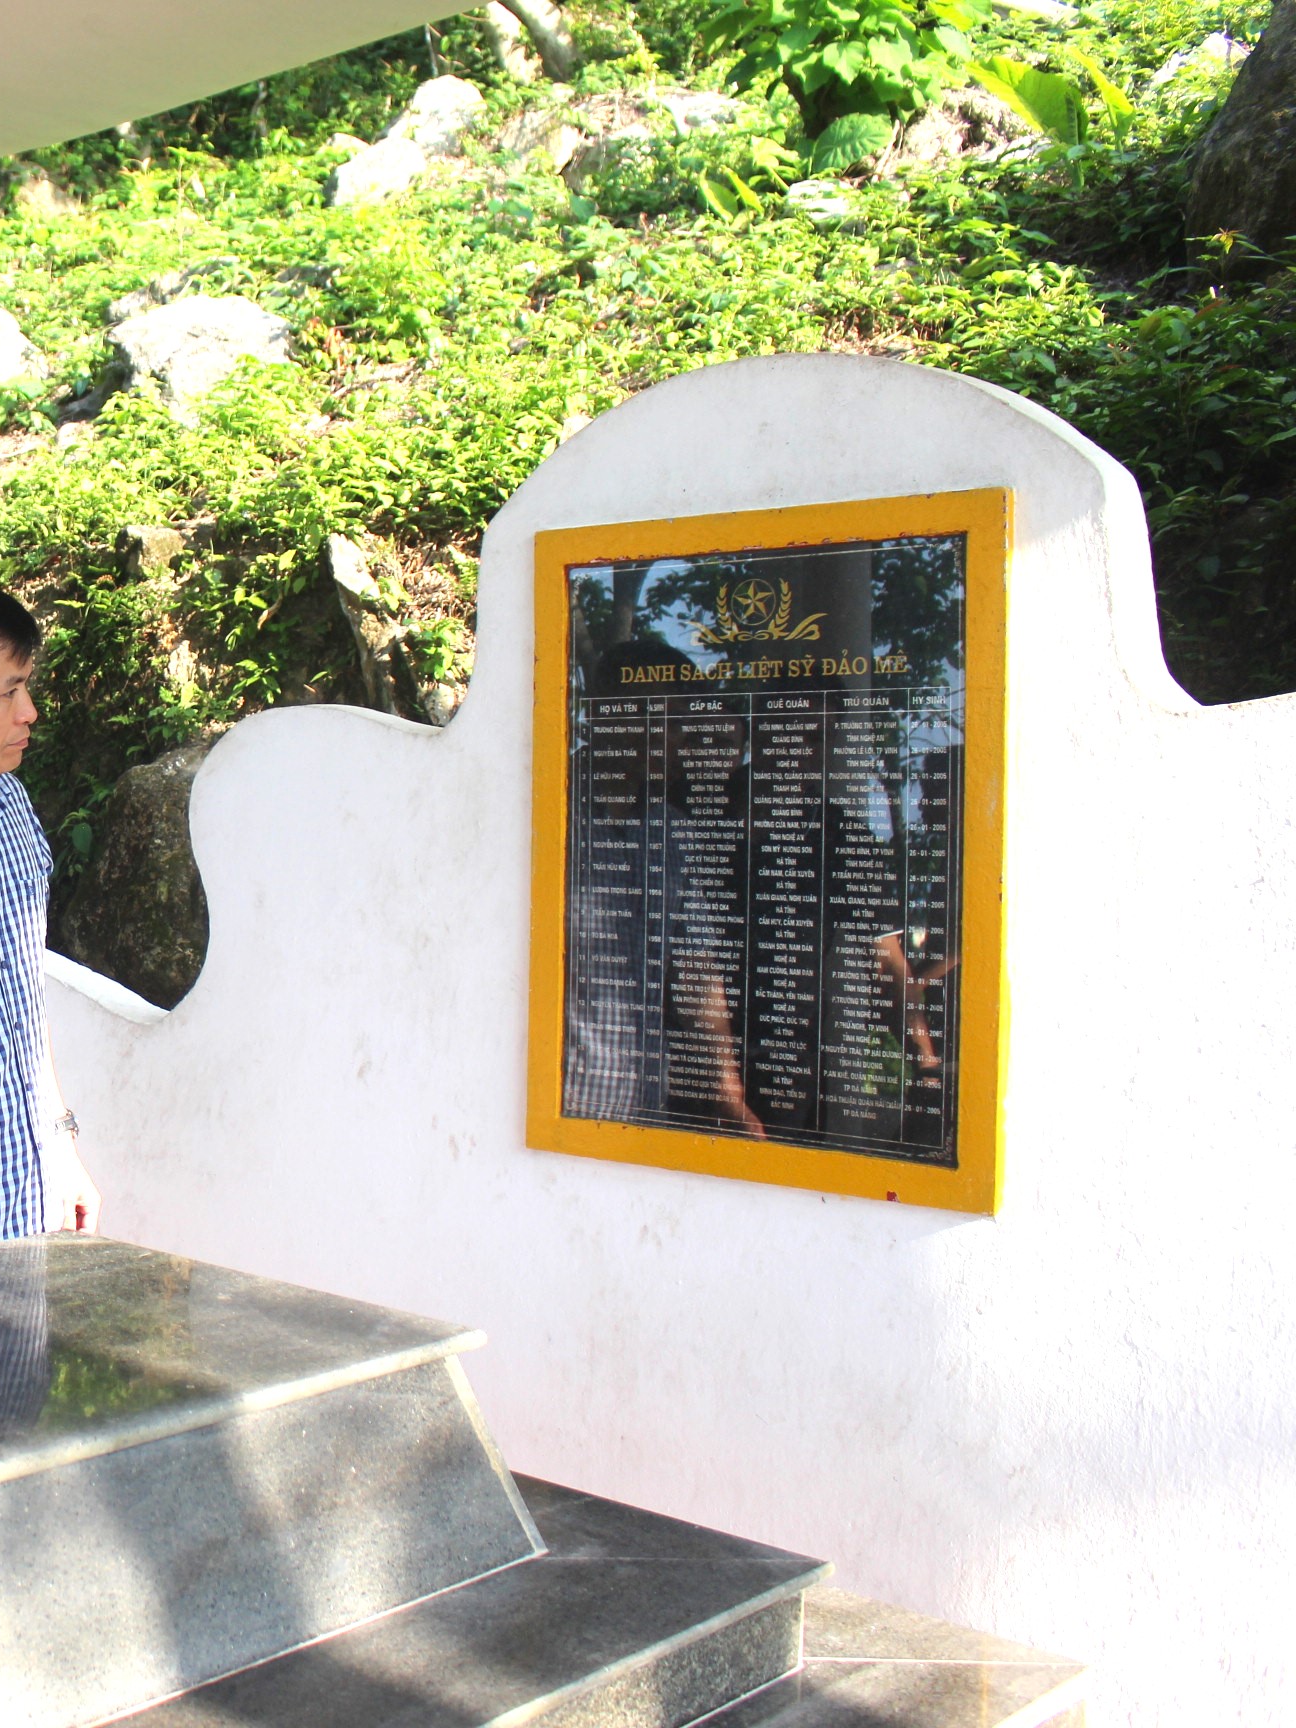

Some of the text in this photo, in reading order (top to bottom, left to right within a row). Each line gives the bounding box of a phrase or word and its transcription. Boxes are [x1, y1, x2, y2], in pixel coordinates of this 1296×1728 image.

[620, 665, 675, 683] DANH
[680, 660, 732, 681] SÁCH
[737, 656, 783, 682] LIỆT
[788, 654, 816, 677] SỸ
[821, 649, 868, 676] ĐẢO
[767, 698, 809, 708] QUÊ QUÁN
[862, 695, 889, 706] QUÁN
[913, 696, 946, 704] HY SINH
